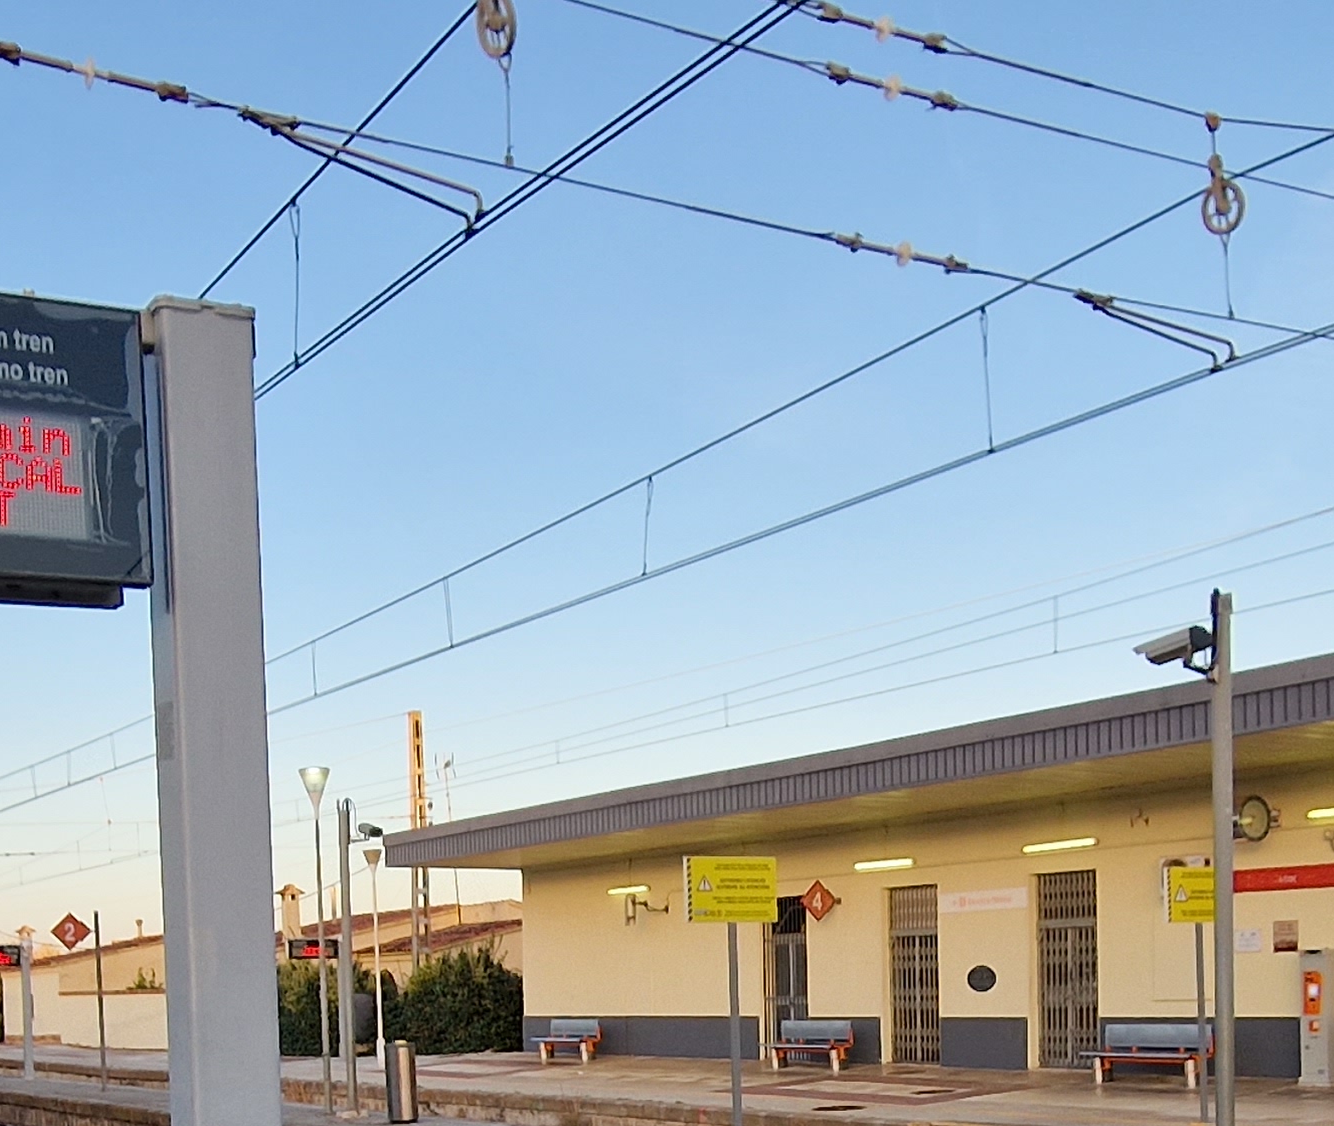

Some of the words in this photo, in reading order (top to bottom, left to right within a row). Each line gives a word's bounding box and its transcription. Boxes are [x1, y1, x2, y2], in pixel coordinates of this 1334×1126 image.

[12, 328, 55, 355] tren
[27, 361, 69, 386] tren
[811, 891, 823, 911] 4
[64, 922, 77, 943] 2
